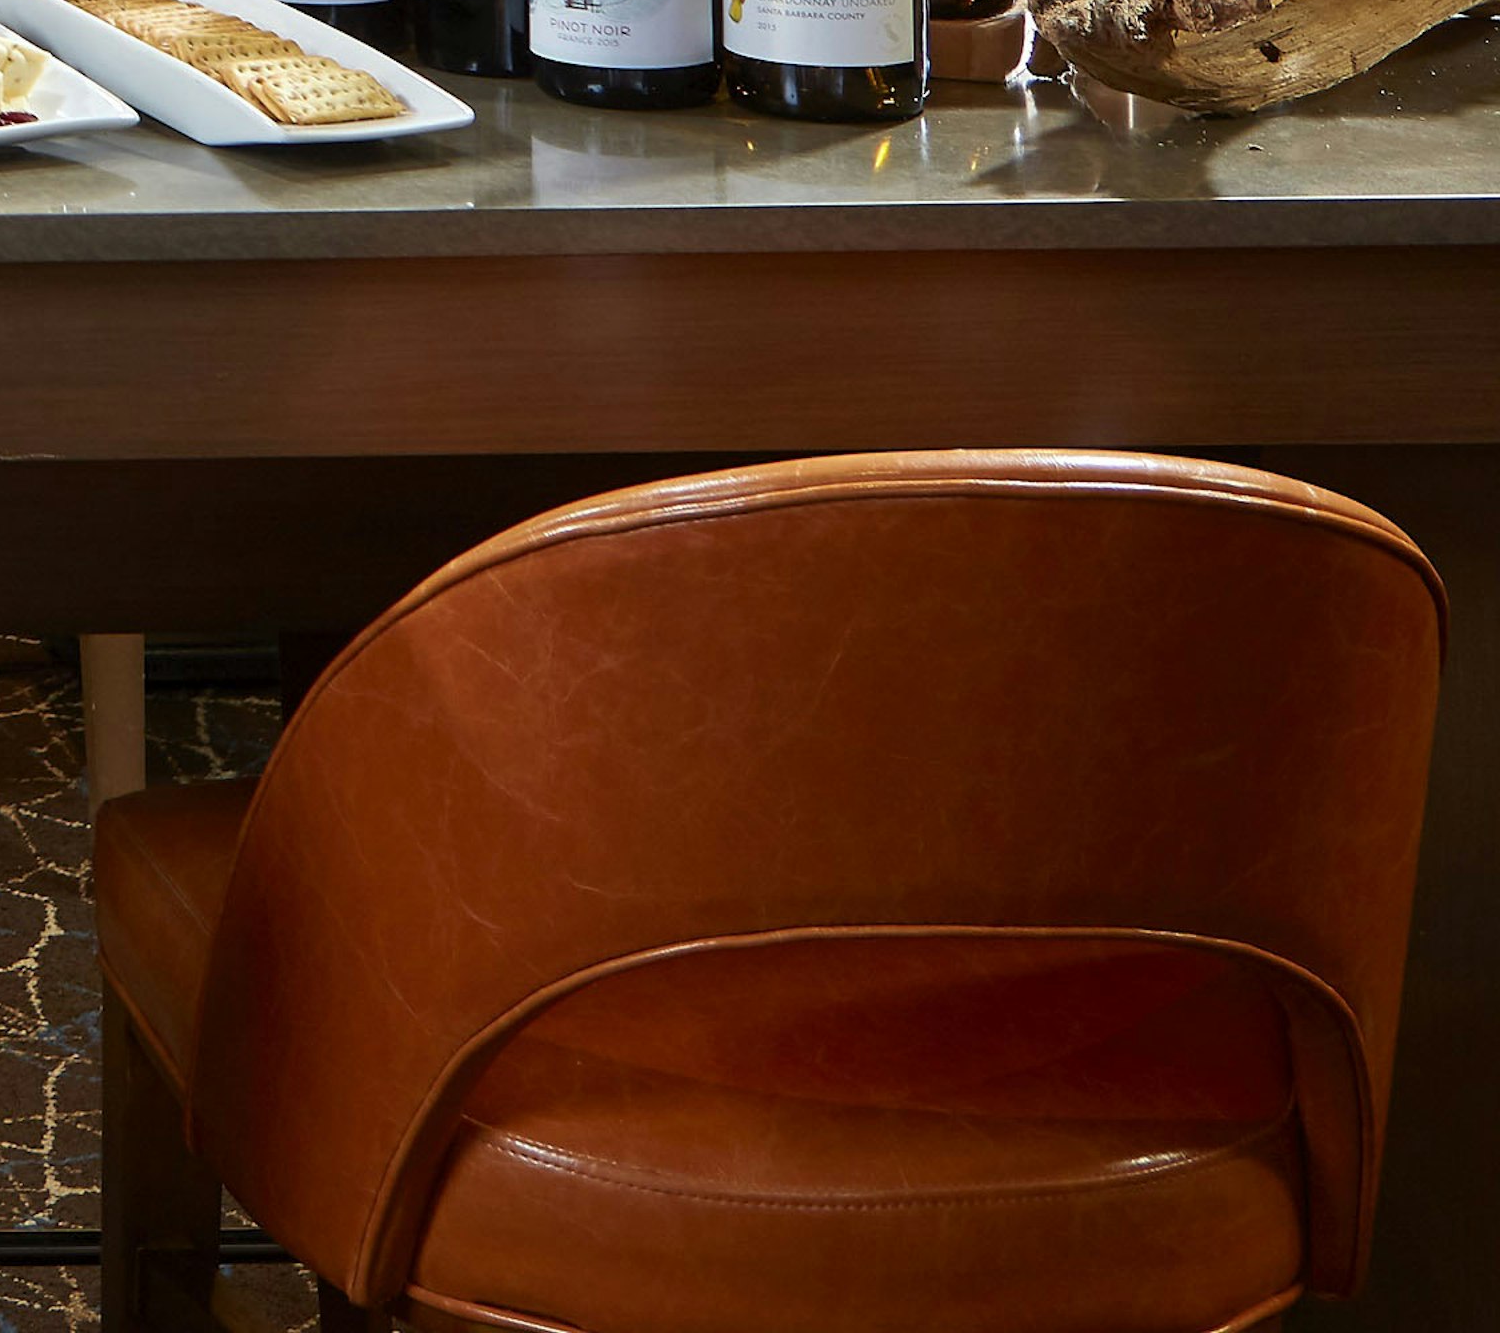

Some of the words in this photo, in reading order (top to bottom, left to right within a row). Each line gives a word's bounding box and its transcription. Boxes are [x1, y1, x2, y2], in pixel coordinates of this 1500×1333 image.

[785, 9, 825, 20] BARBARA
[827, 11, 866, 21] COUNTY
[550, 17, 588, 34] PINOT
[592, 24, 632, 37] NOIR
